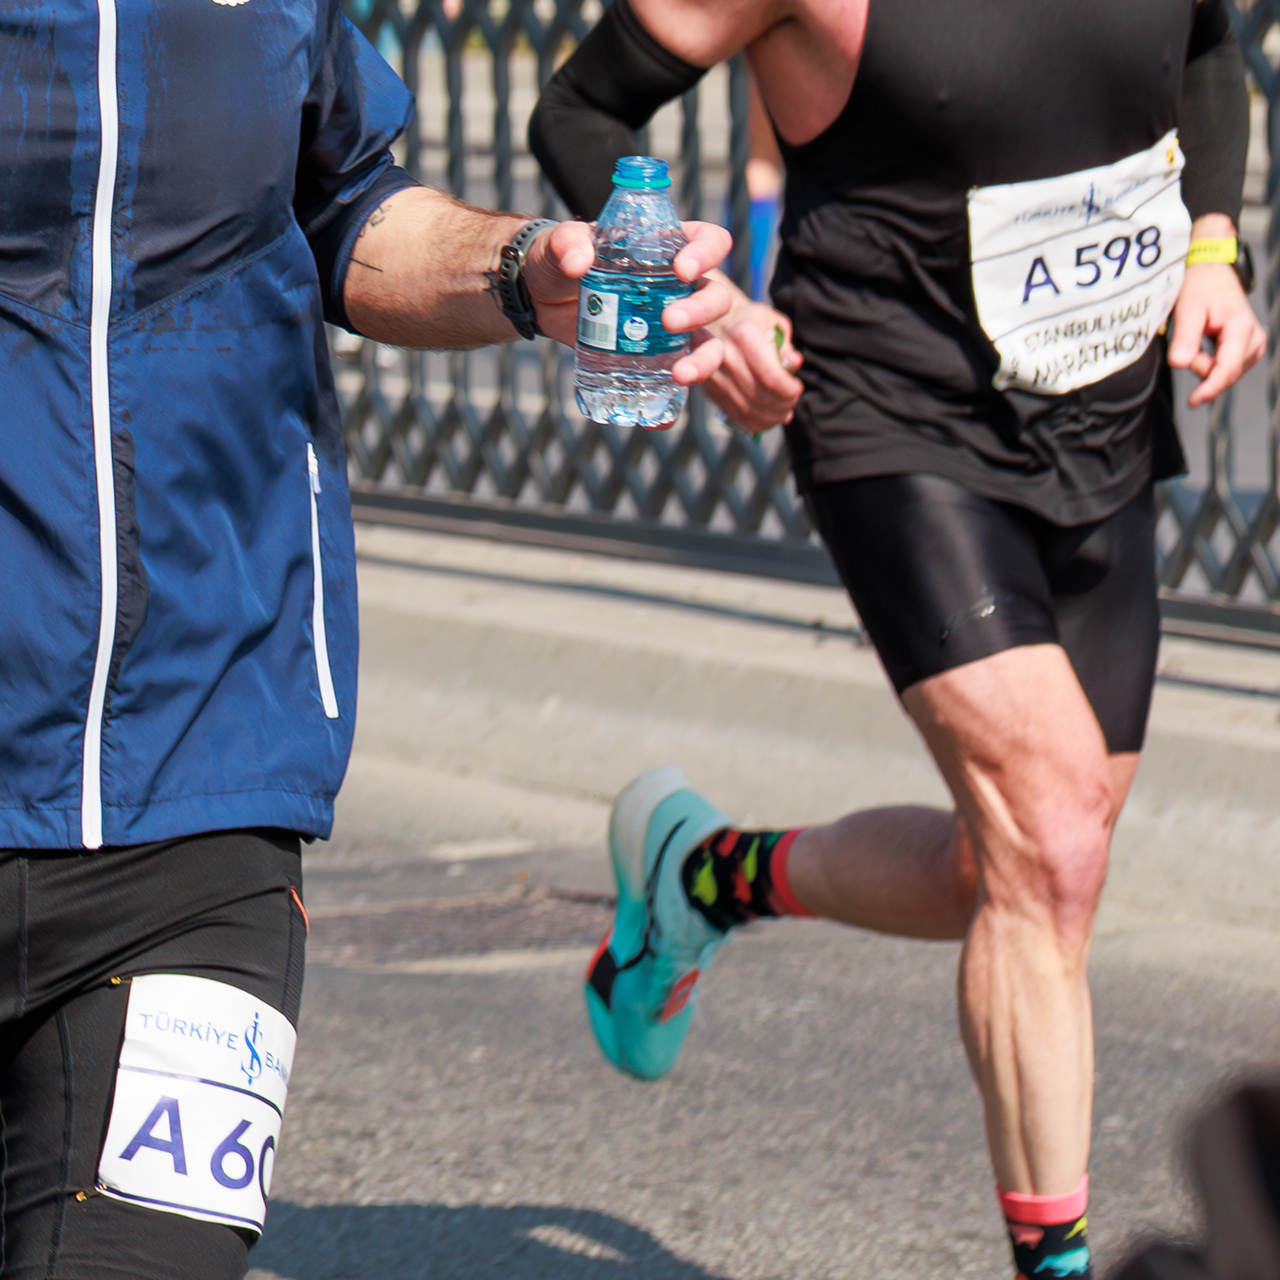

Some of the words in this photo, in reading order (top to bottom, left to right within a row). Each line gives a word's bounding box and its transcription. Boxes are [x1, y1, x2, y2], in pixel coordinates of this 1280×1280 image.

[1022, 256, 1060, 305] A
[1074, 225, 1162, 288] 598
[1032, 321, 1151, 387] MARATHON
[139, 1011, 239, 1051] TÜRKİYE
[118, 1095, 188, 1177] A
